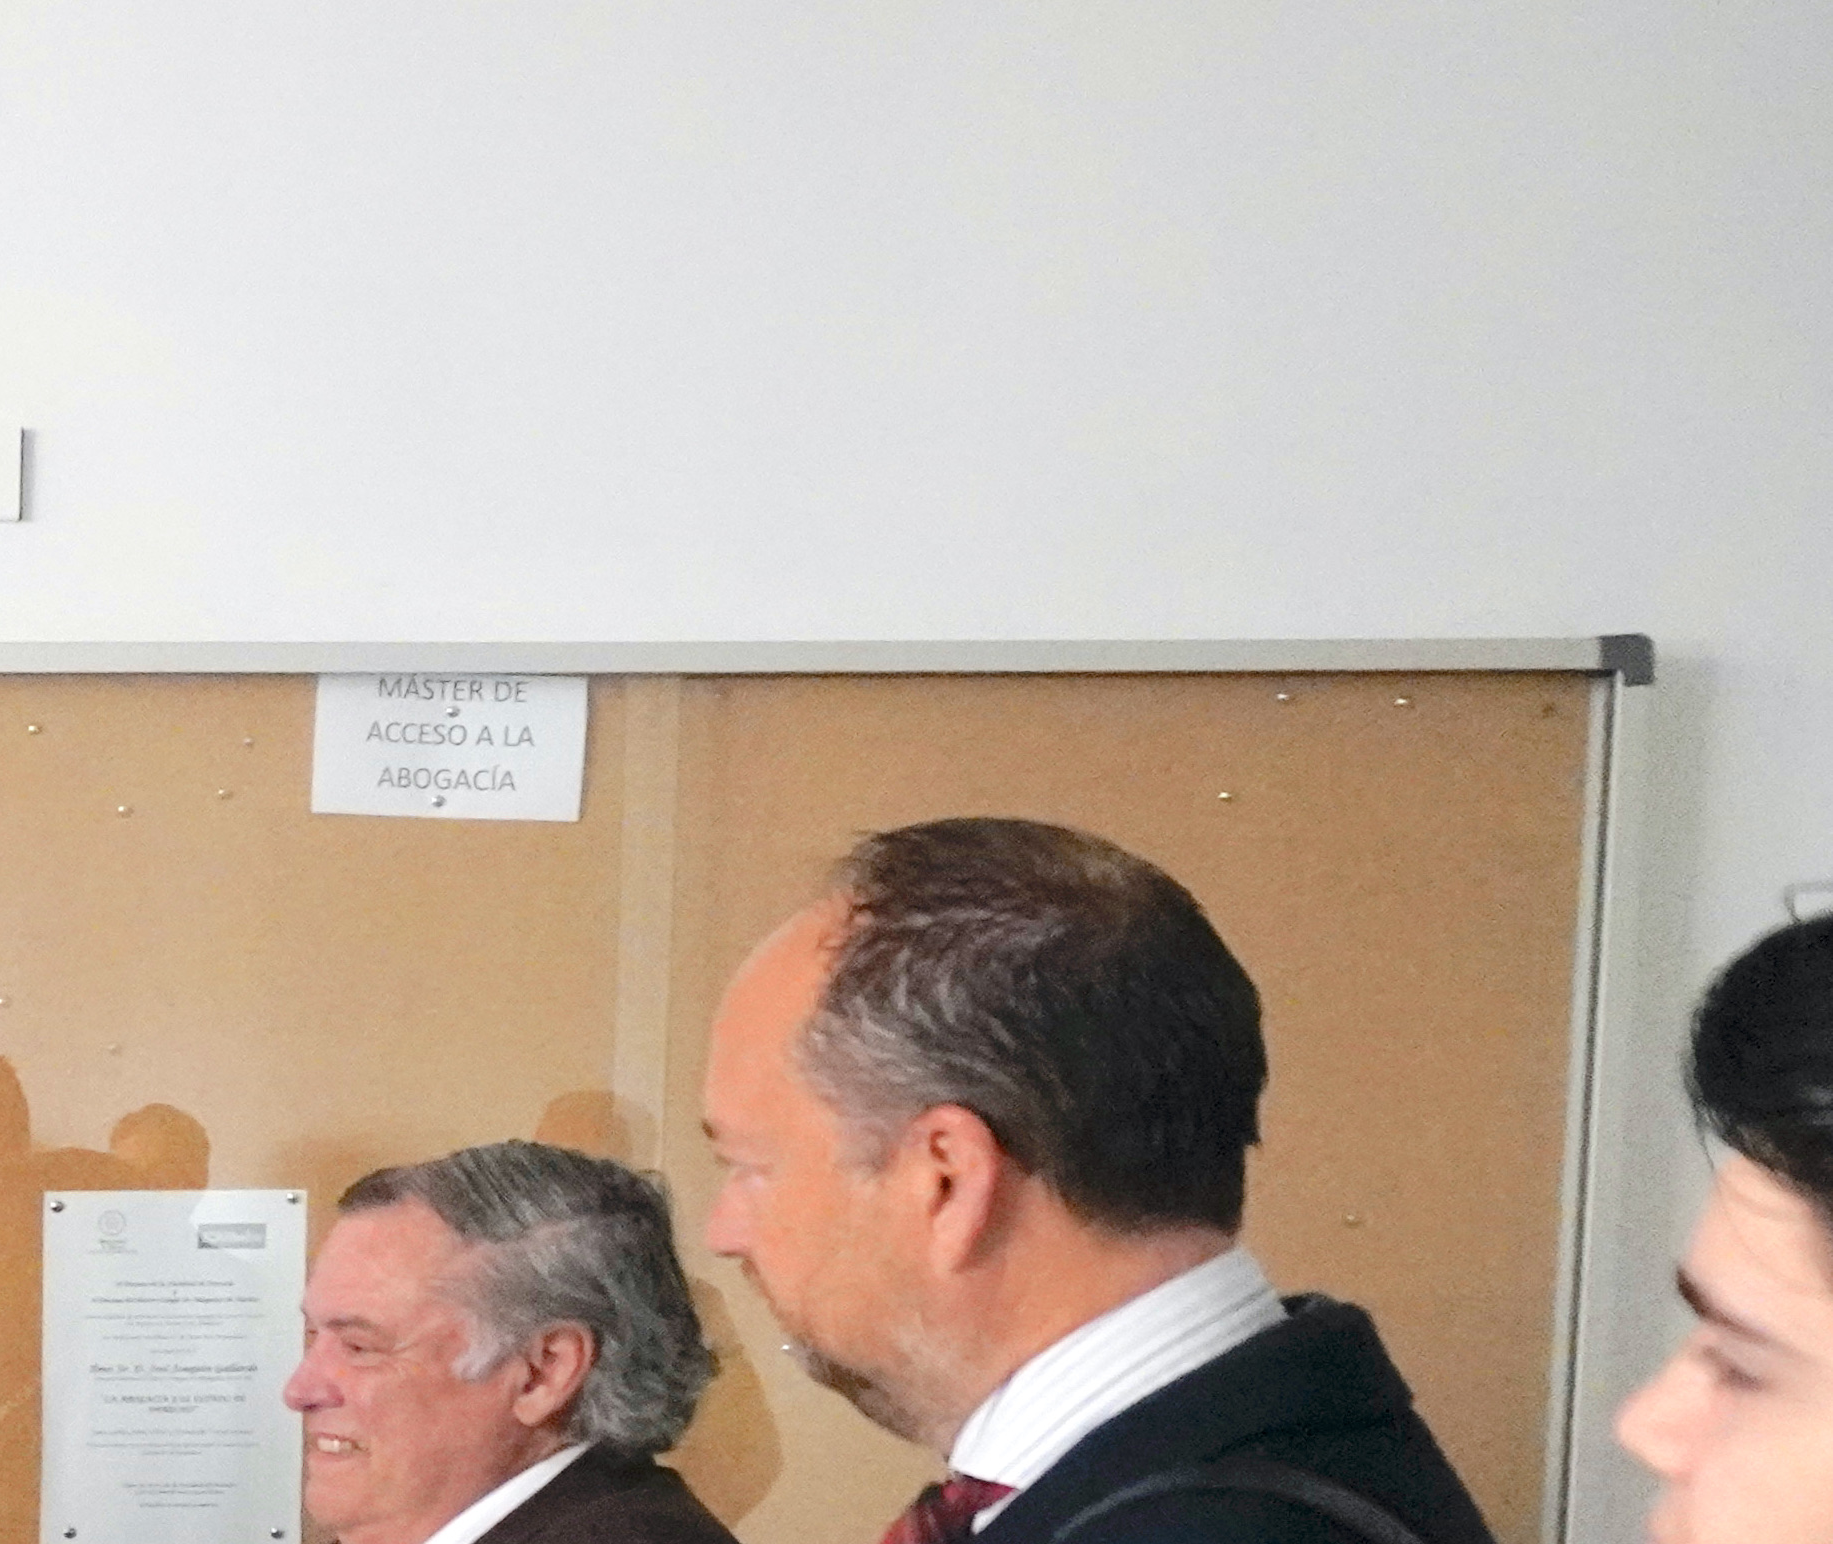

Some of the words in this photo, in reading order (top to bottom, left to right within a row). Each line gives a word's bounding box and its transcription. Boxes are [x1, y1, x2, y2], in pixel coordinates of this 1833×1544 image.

[378, 675, 484, 703] MÁSTER
[495, 681, 529, 704] DE
[366, 721, 468, 747] ACCESO
[476, 725, 494, 747] A
[504, 725, 536, 747] LA
[377, 765, 517, 792] ABOGACÍA
